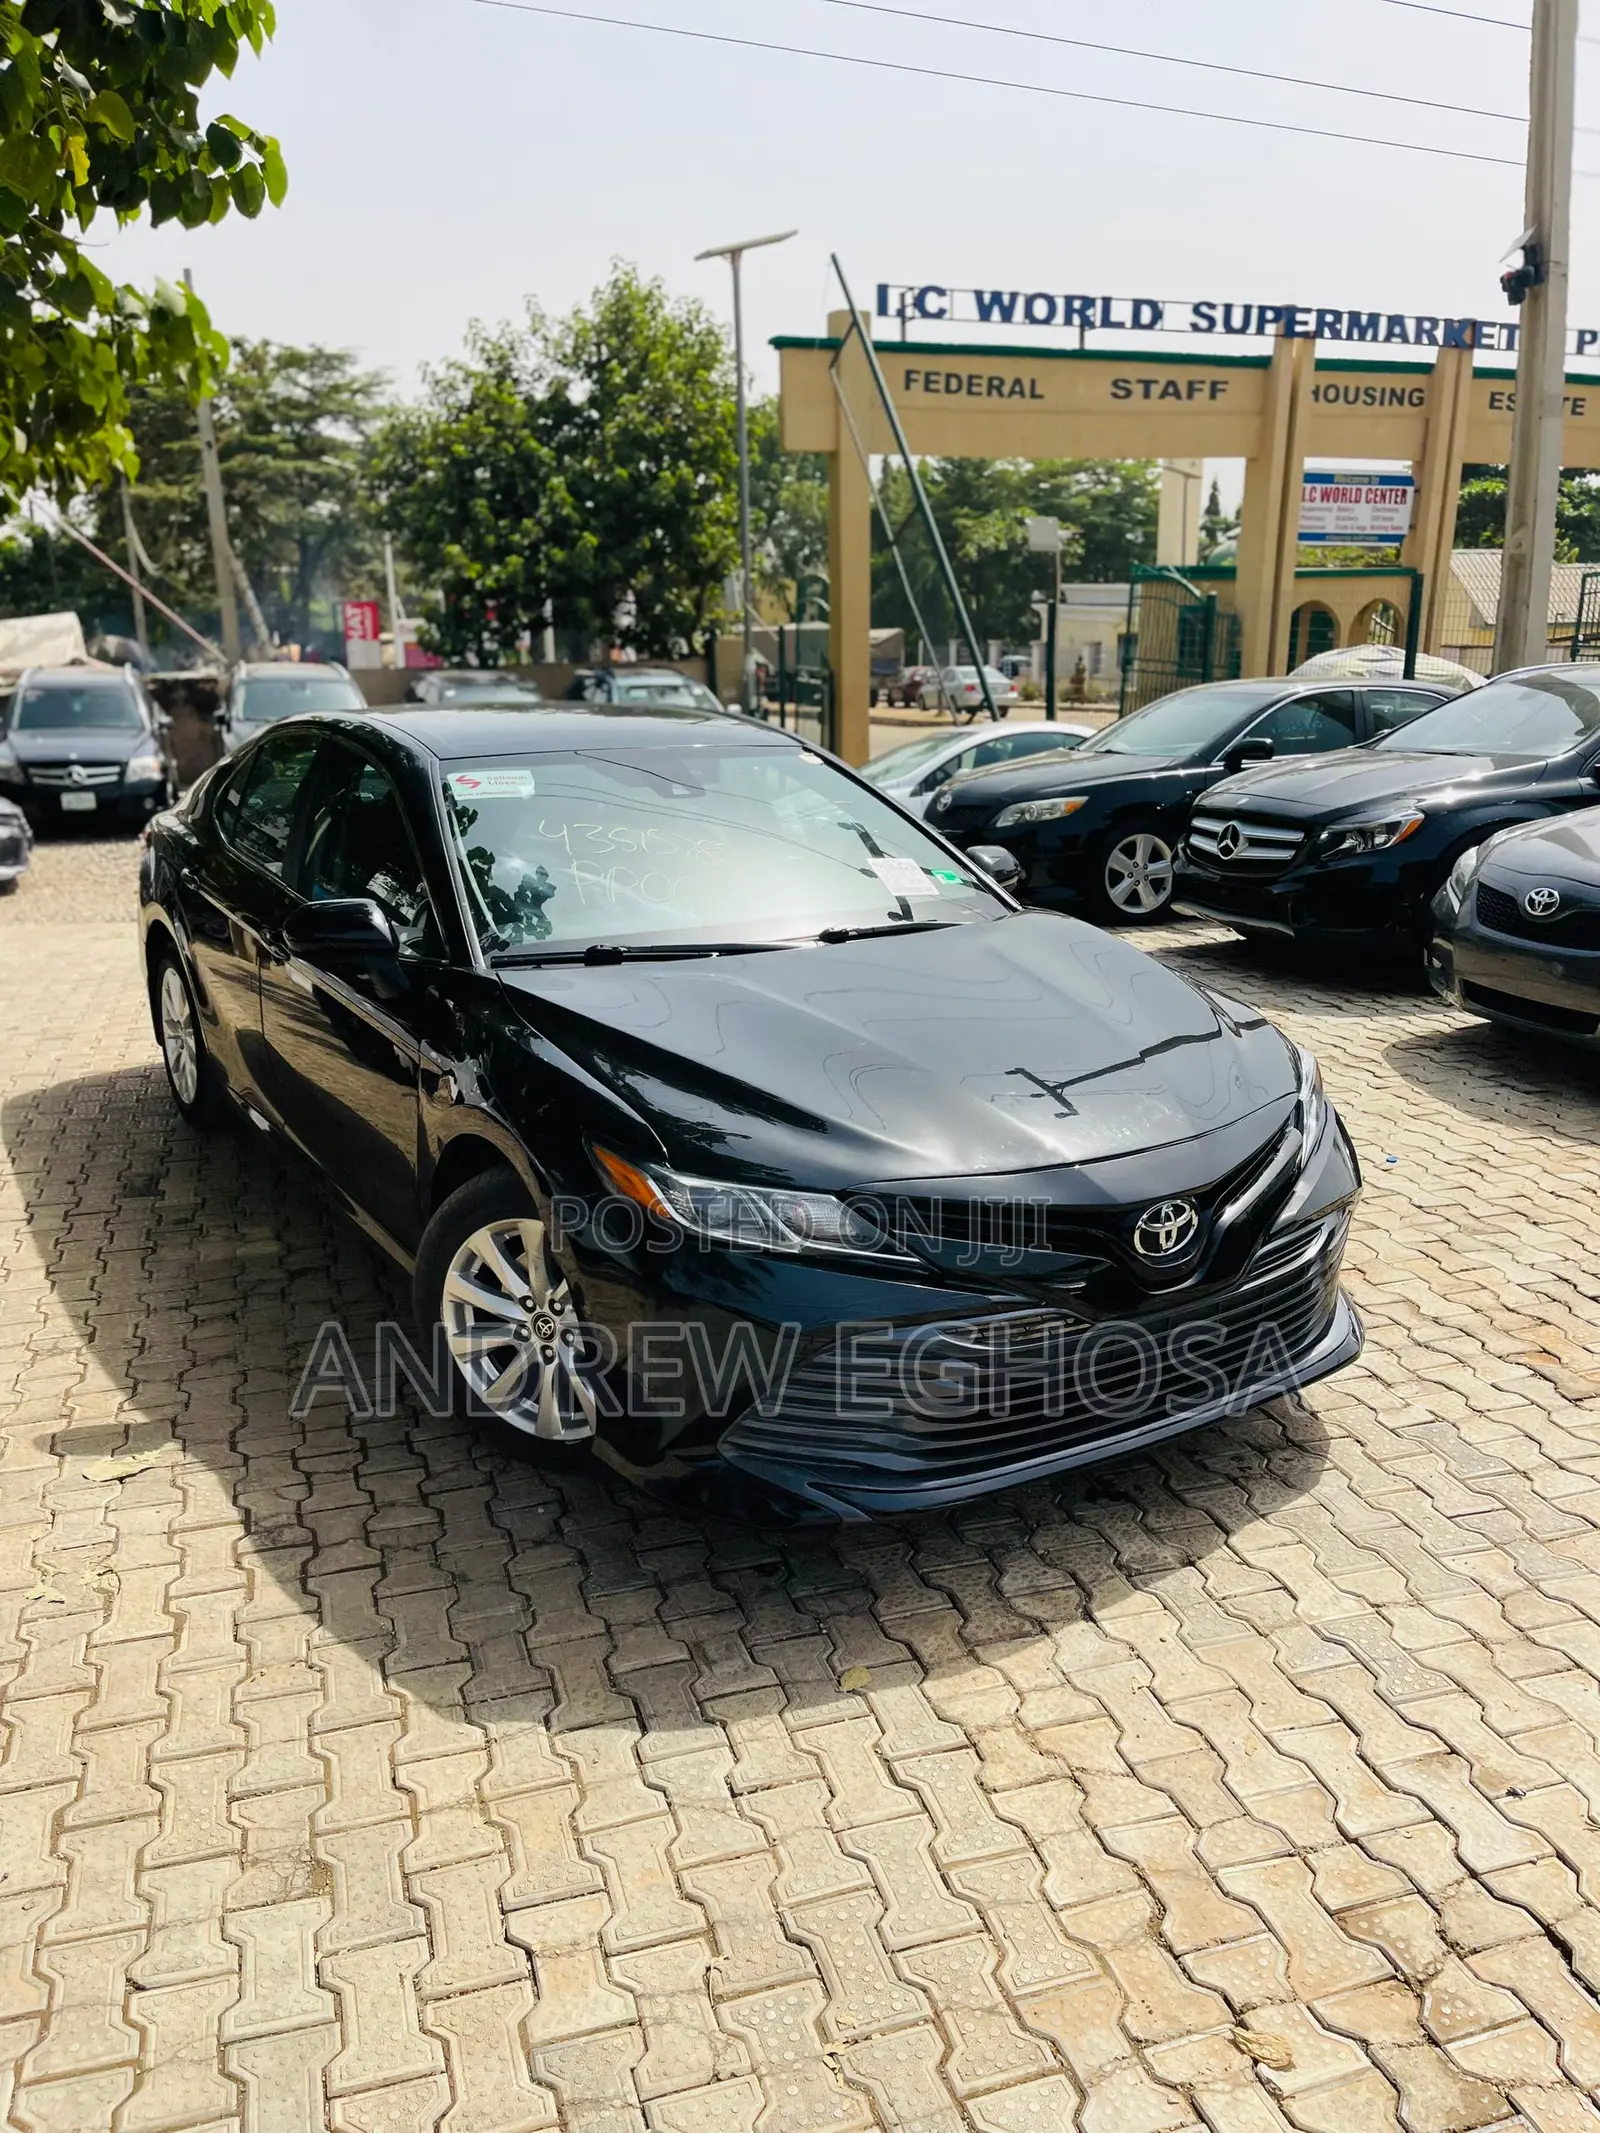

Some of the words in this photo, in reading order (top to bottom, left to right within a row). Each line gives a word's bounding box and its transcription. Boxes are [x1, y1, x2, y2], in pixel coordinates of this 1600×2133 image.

[973, 290, 1163, 329] WORLD
[1190, 301, 1521, 351] SUPERMARKET
[904, 369, 1045, 399] FEDERAL
[1110, 378, 1229, 400] STAFF
[1488, 391, 1587, 416] ESE
[1320, 487, 1362, 504] WORLD
[1365, 487, 1408, 505] CENTER
